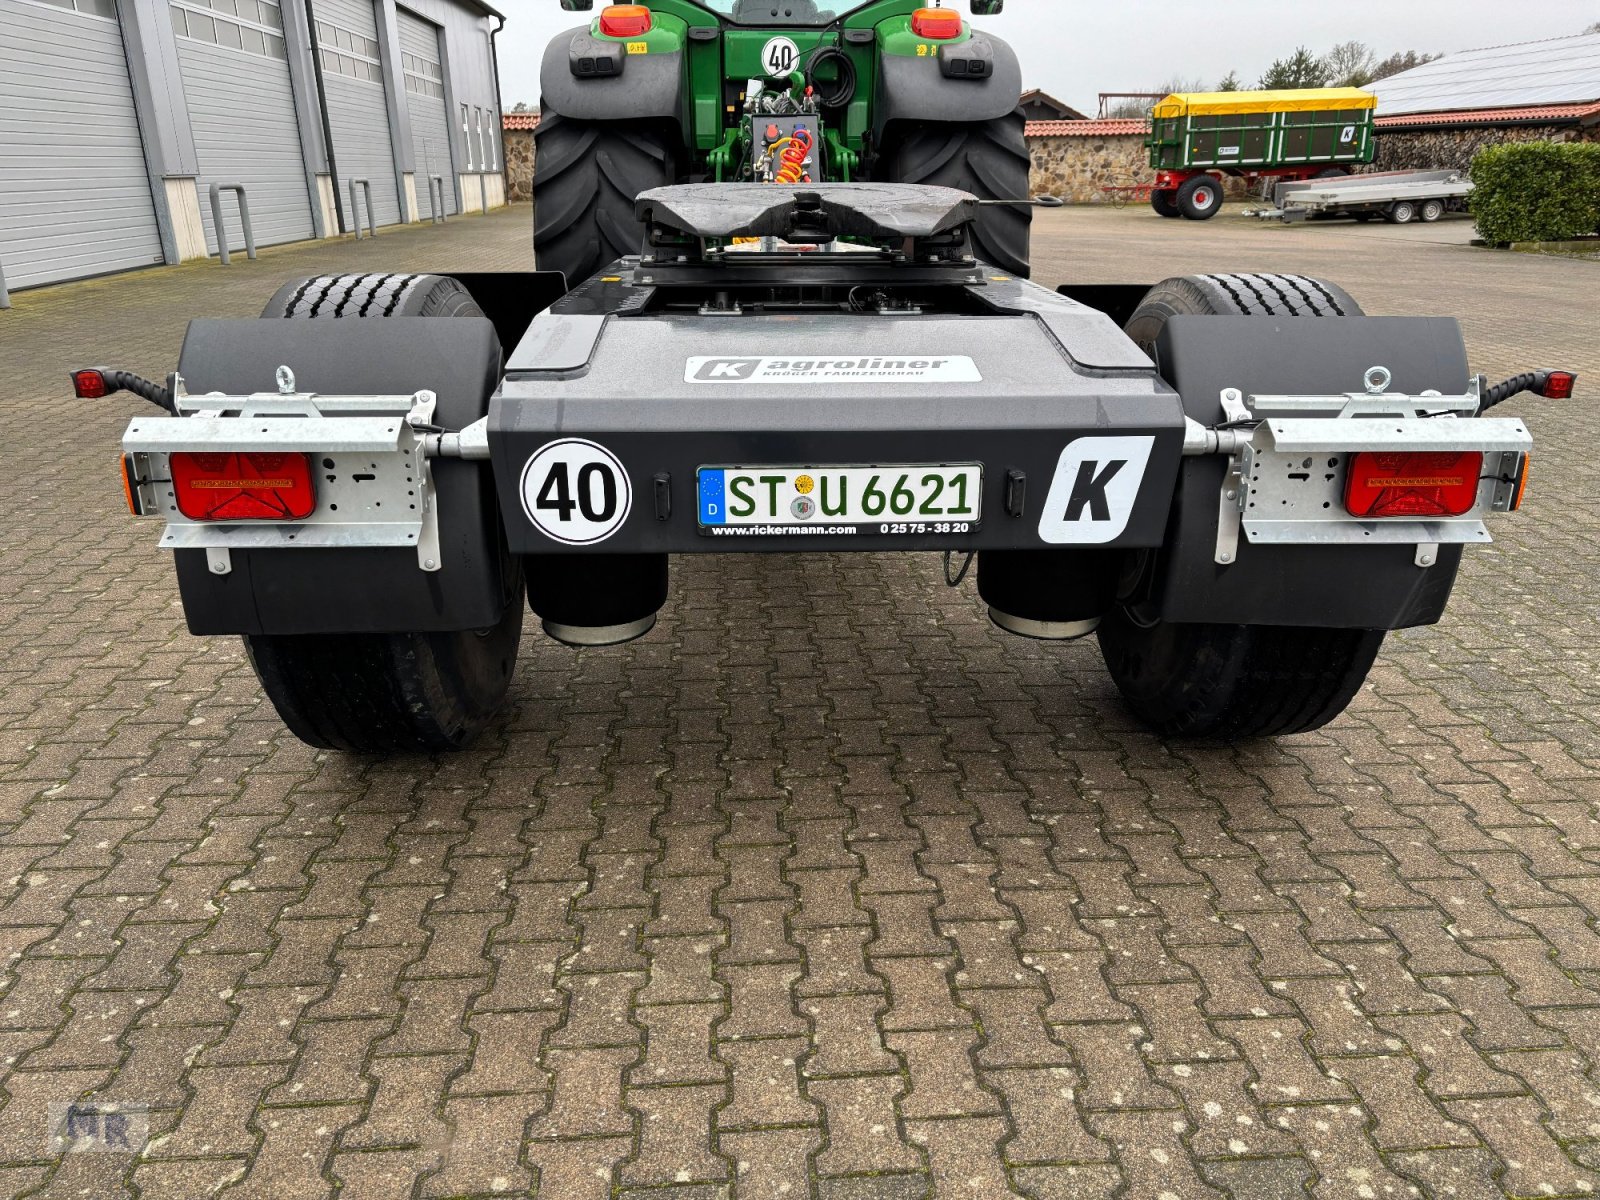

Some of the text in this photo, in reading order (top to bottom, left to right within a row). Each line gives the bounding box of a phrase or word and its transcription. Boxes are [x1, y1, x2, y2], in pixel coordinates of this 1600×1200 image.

[769, 45, 792, 71] 40
[766, 357, 949, 372] agroliner
[535, 461, 618, 523] 40
[729, 473, 972, 517] ST U 6621
[1062, 459, 1129, 522] K
[708, 503, 718, 515] D
[711, 525, 857, 536] www.rickermann.com
